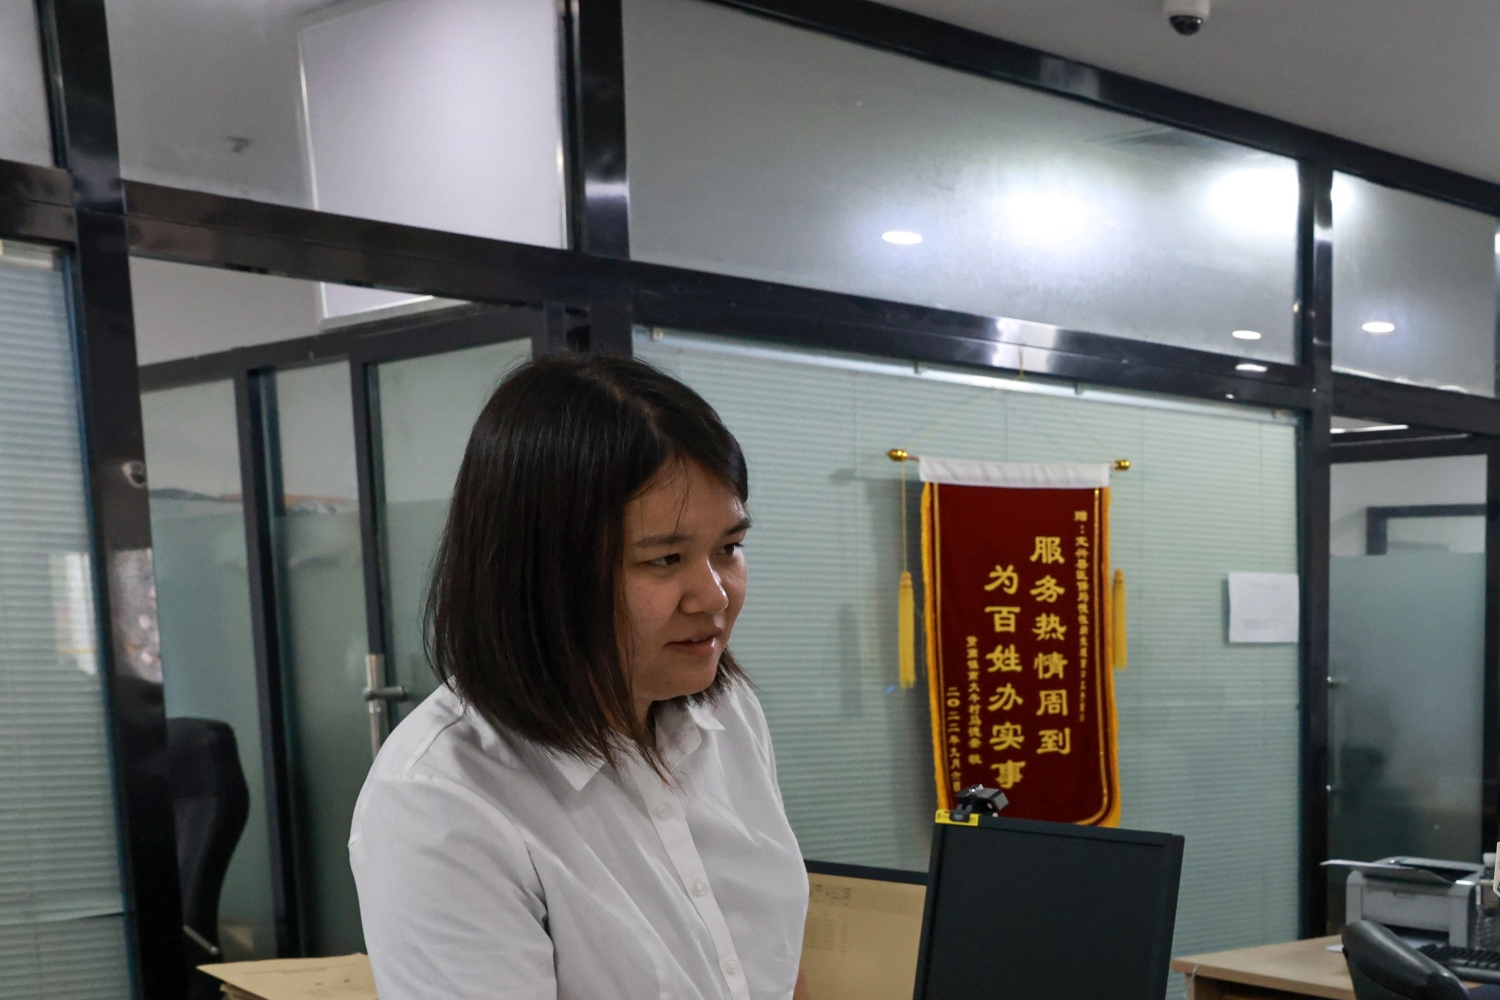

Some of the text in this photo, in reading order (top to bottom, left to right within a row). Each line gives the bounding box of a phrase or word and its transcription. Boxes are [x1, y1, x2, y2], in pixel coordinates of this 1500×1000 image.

[984, 565, 1026, 789] 为百姓办实事
[1030, 536, 1071, 755] 服务热情周到
